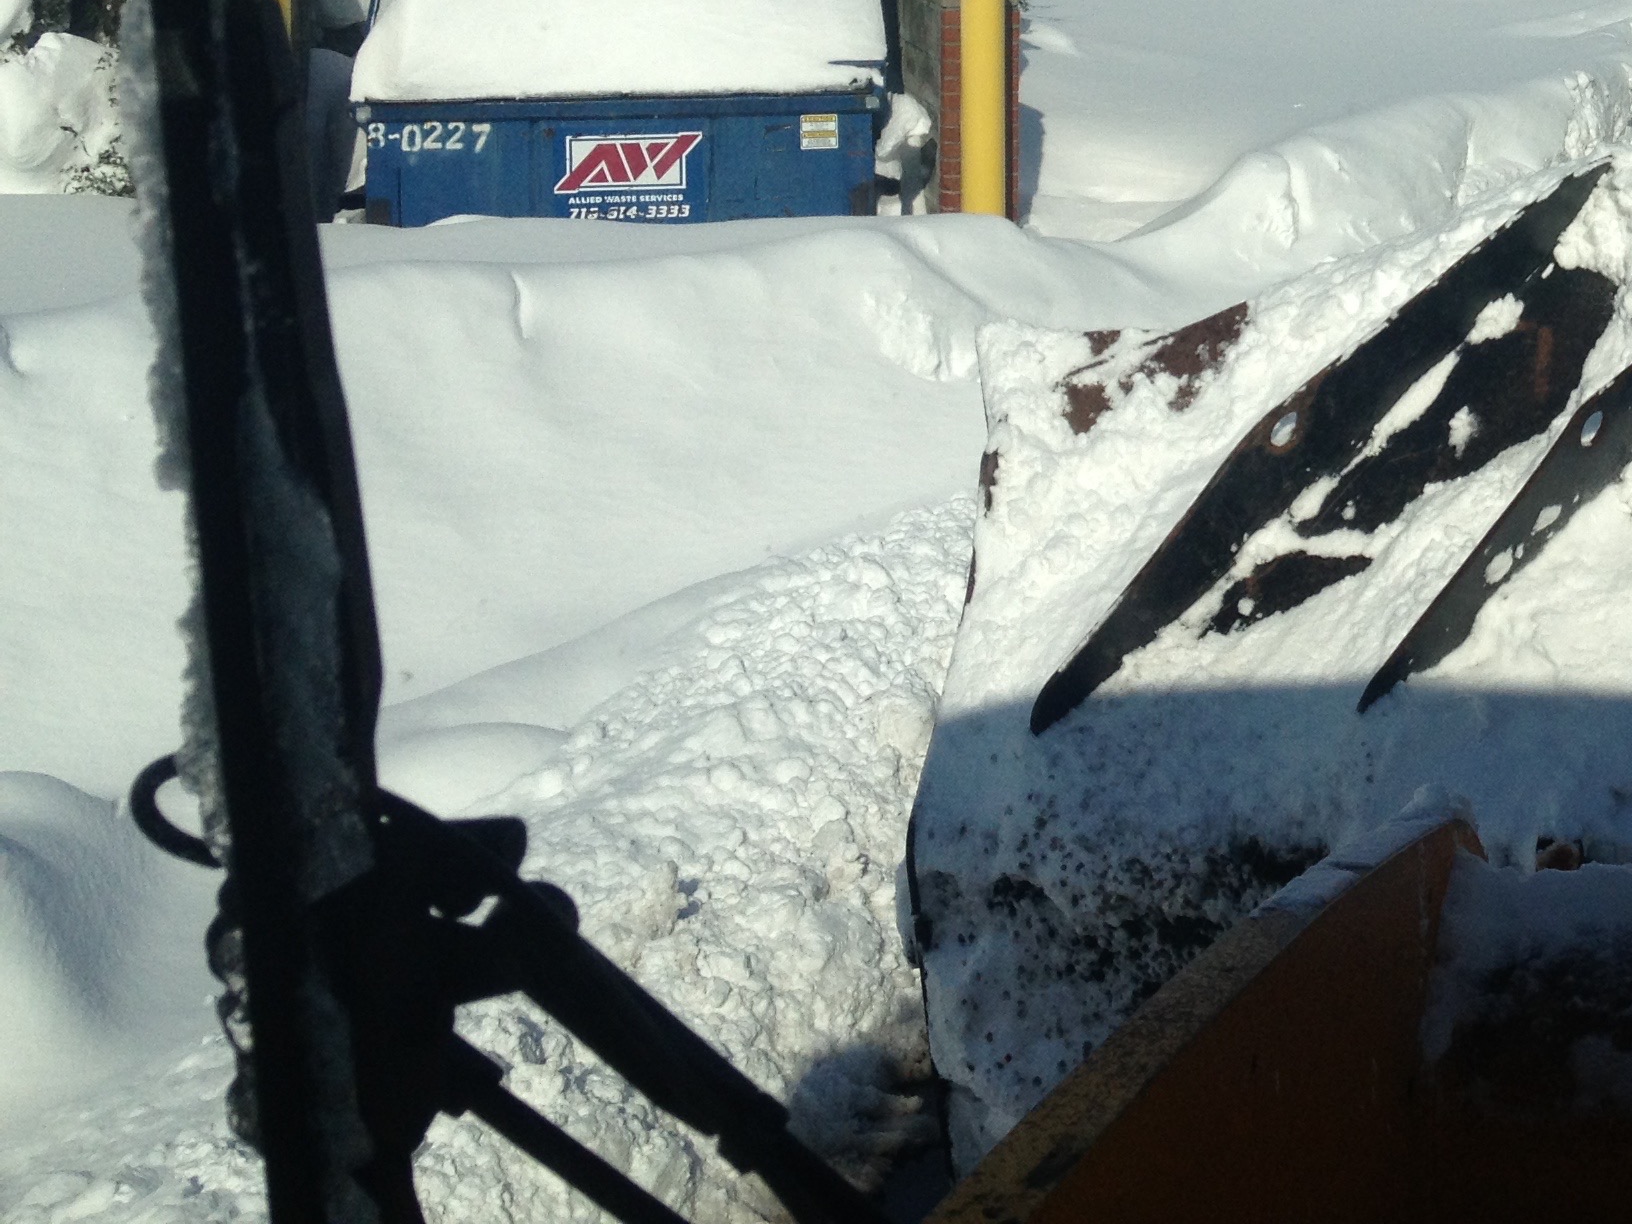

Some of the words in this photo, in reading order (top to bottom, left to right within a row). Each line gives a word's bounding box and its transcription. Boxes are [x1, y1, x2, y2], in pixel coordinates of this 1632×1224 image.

[568, 196, 603, 205] ALLIED
[604, 195, 637, 204] WASTE
[639, 193, 684, 203] SERVICES
